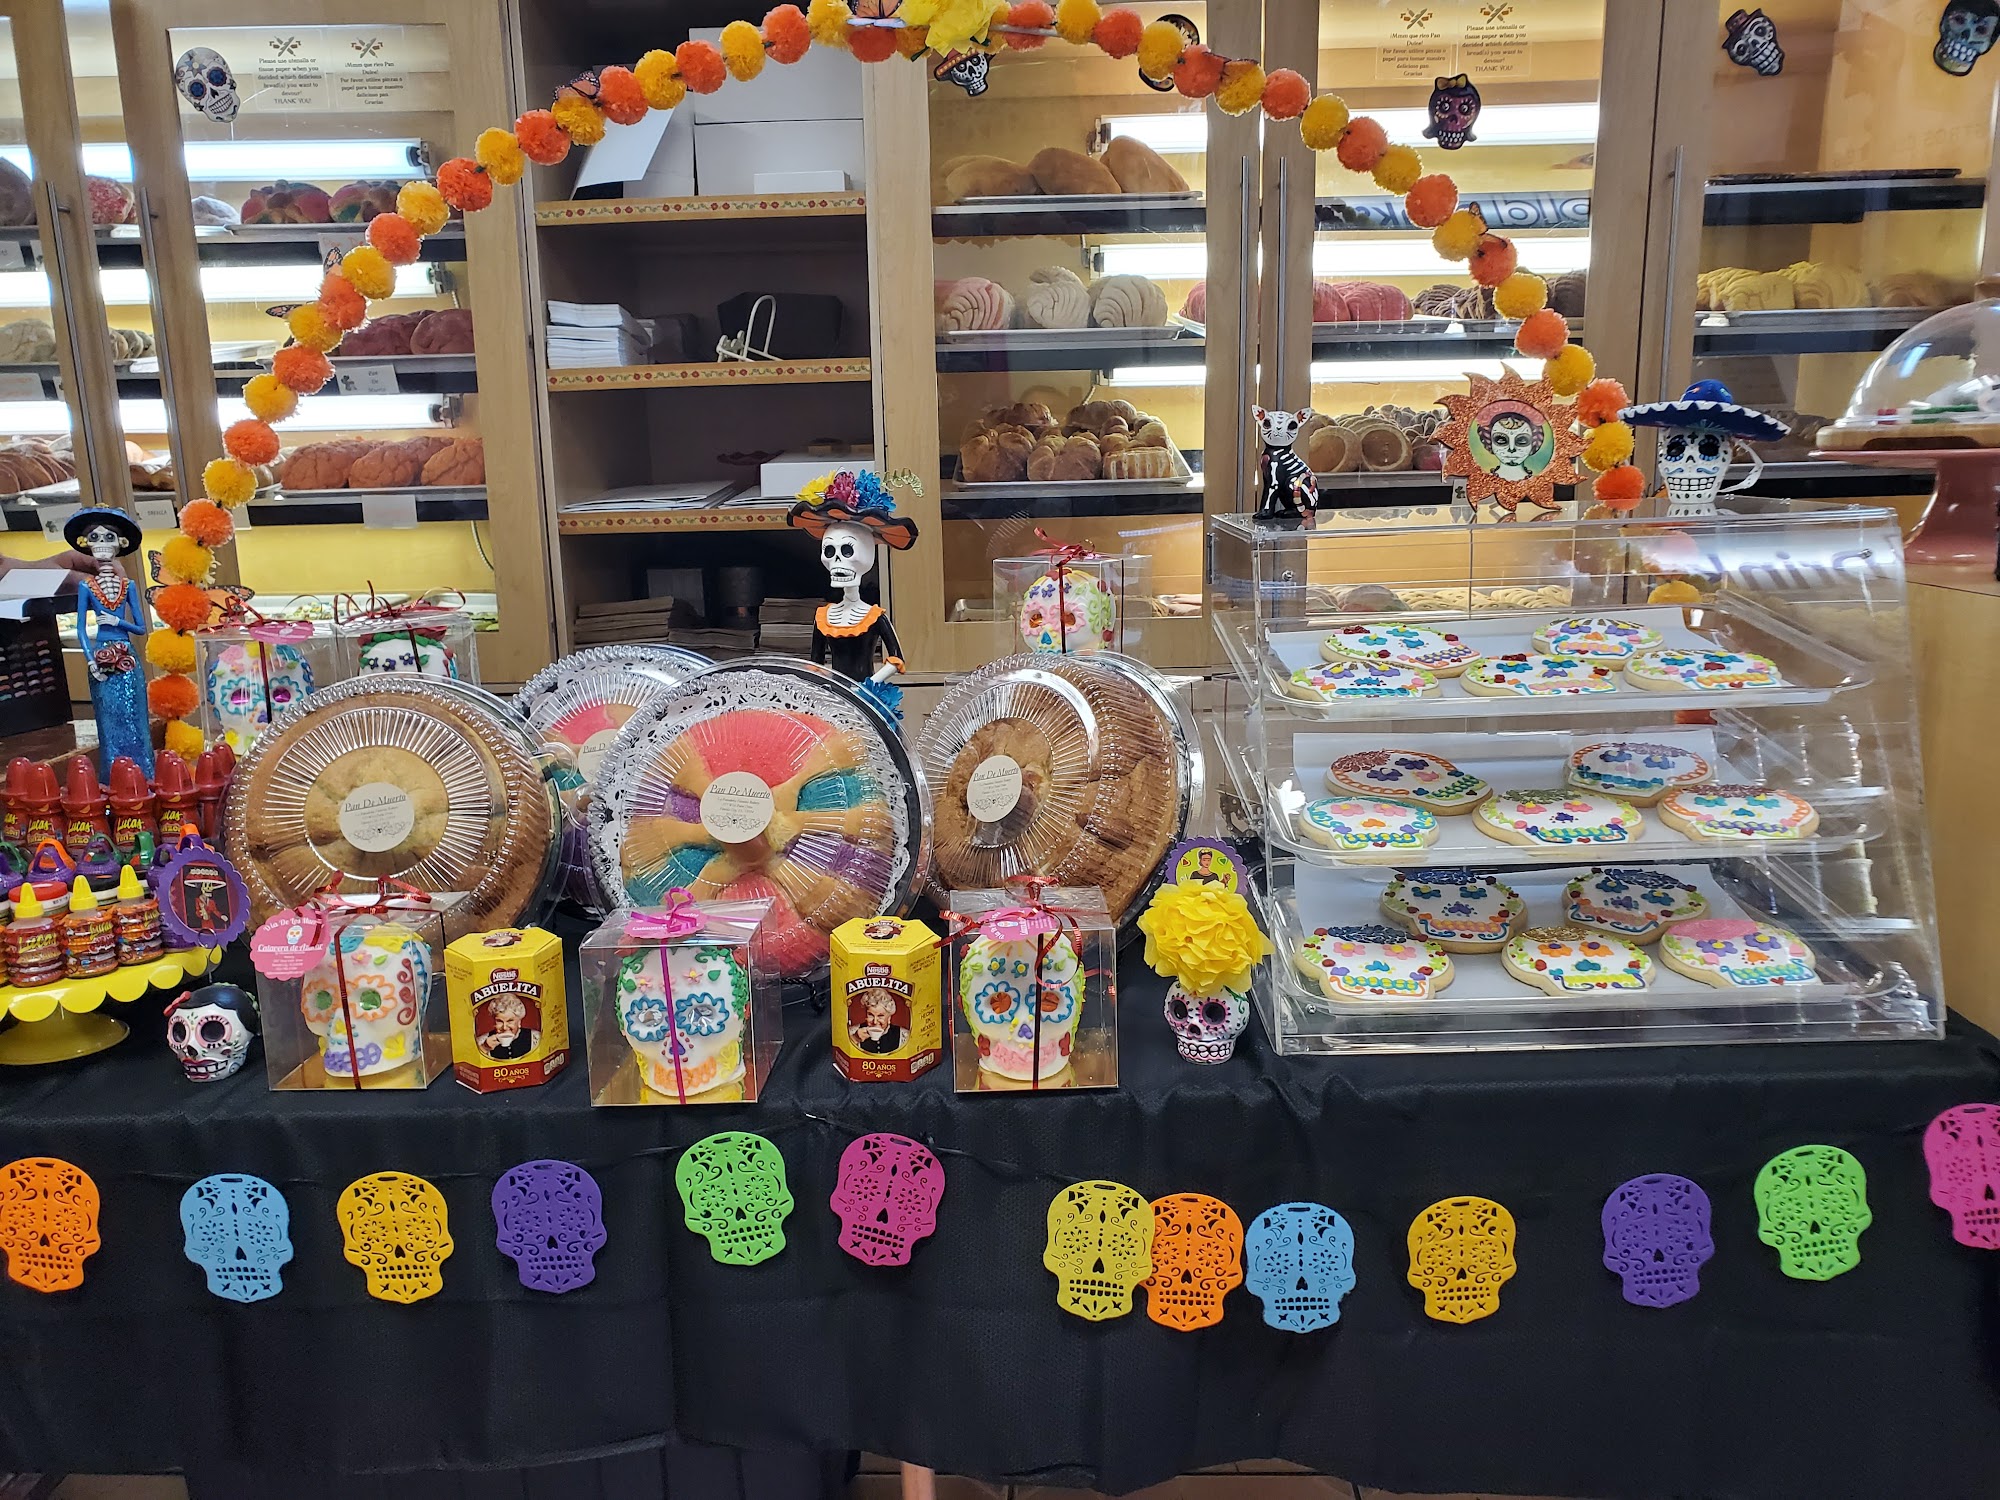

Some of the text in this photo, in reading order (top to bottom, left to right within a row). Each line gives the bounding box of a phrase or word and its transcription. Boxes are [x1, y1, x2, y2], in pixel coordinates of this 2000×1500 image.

[583, 745, 597, 753] Pan
[973, 767, 1019, 781] Pan De Muerto
[709, 784, 771, 798] Pan De Muerto
[344, 794, 406, 812] Pan De Muerto
[28, 819, 53, 833] Lucas
[67, 819, 93, 833] Lucas
[116, 817, 144, 832] Lucas
[257, 944, 289, 952] Calavera
[473, 982, 538, 1003] ABUELITA
[847, 978, 909, 993] ABUELITA
[493, 1067, 530, 1078] 80 AÑOS
[862, 1061, 897, 1071] 80 AÑOS
